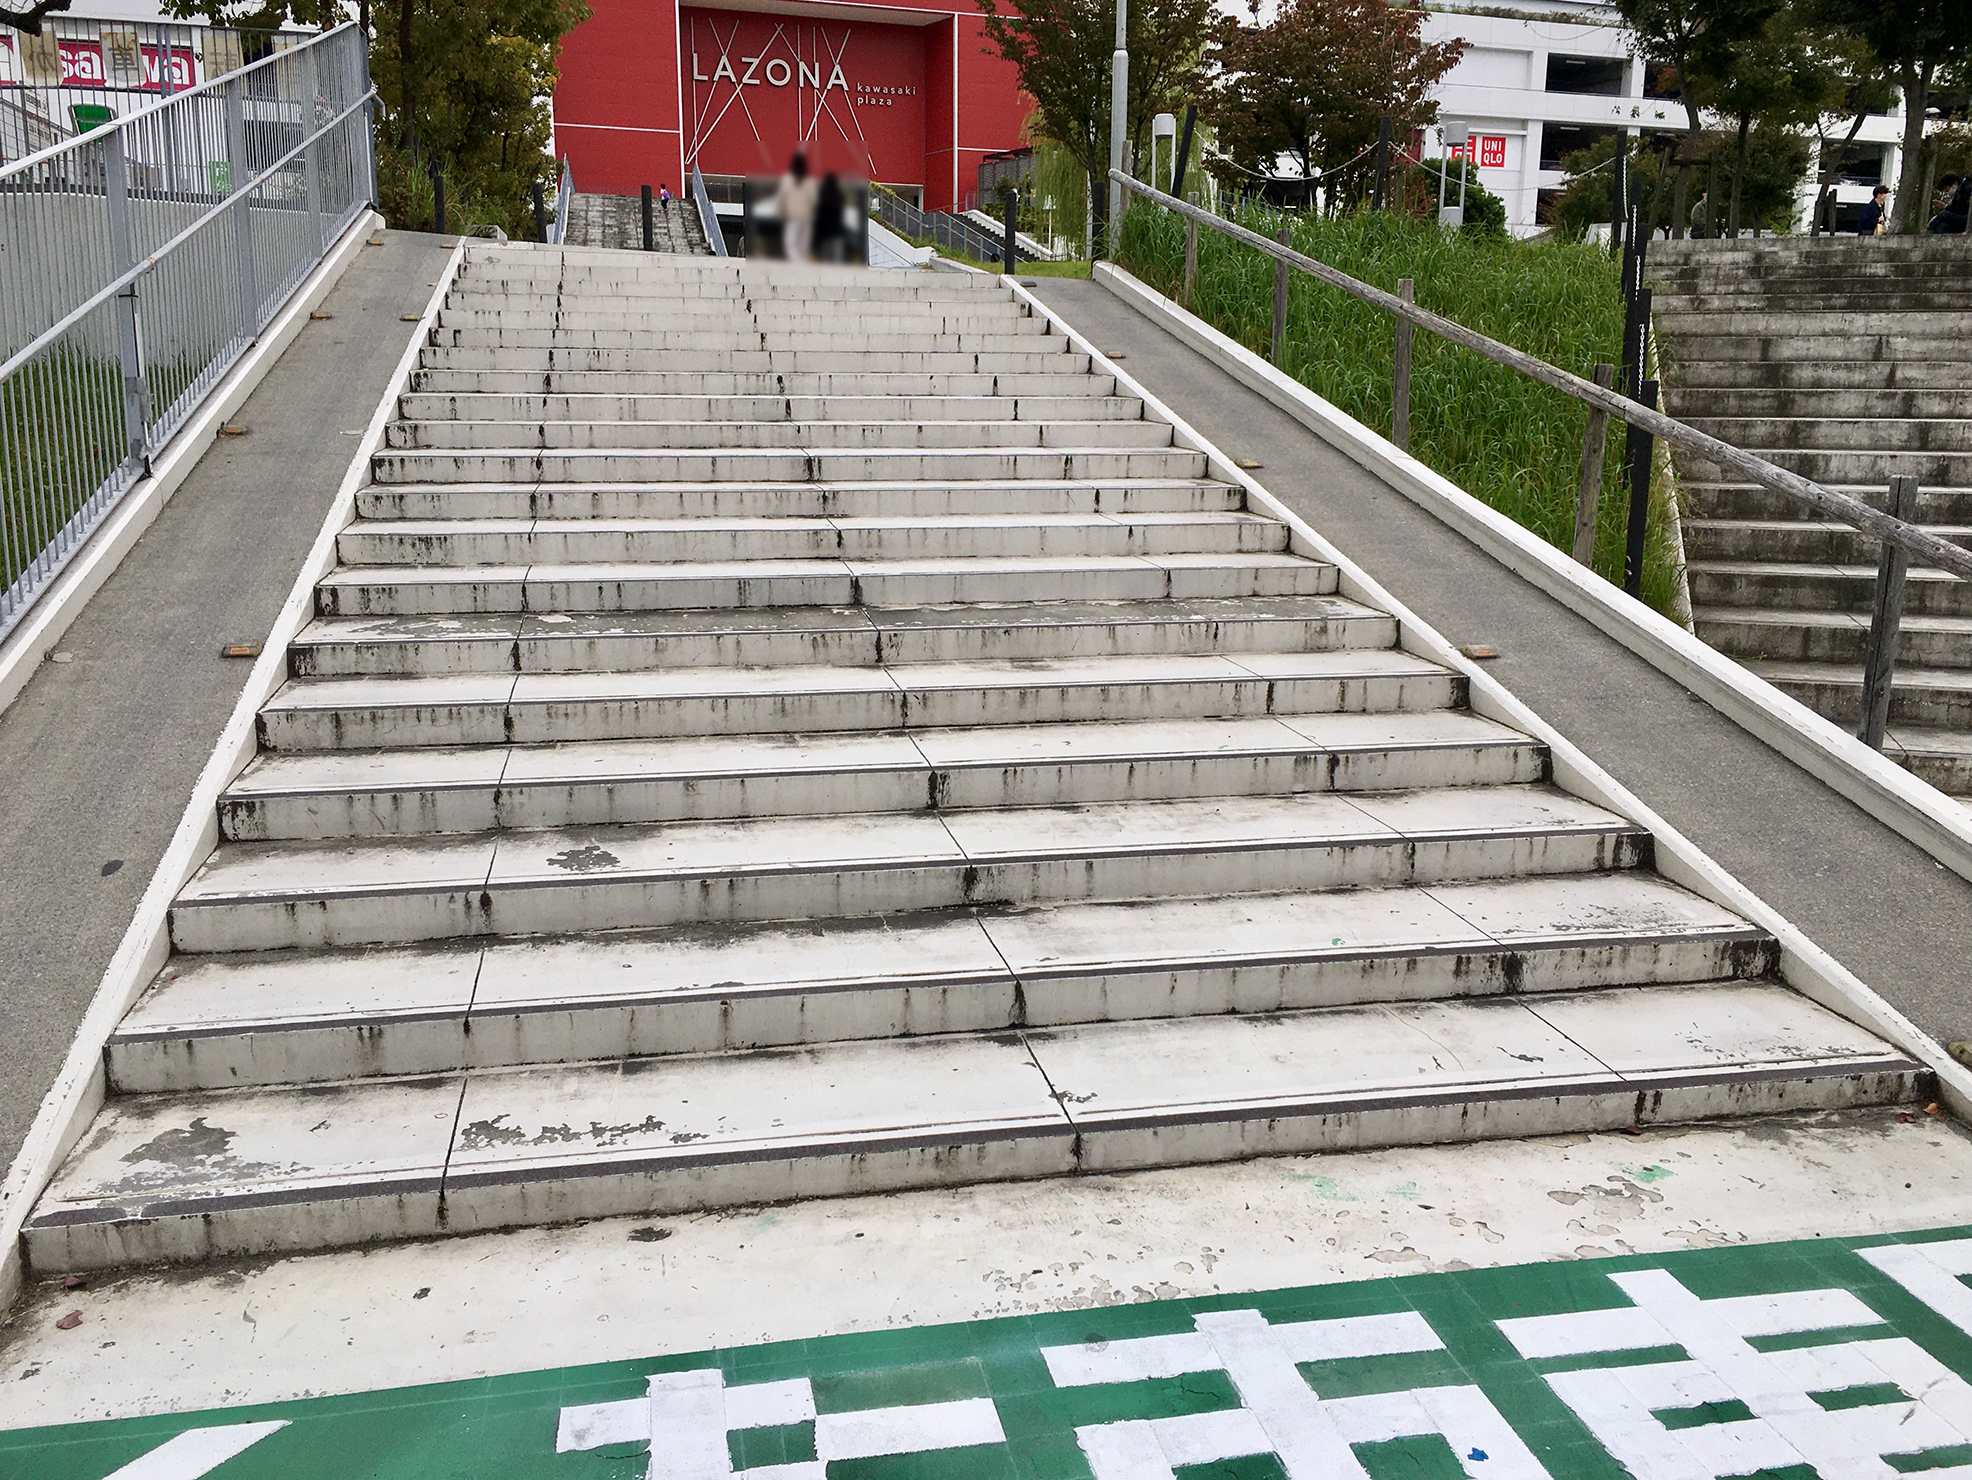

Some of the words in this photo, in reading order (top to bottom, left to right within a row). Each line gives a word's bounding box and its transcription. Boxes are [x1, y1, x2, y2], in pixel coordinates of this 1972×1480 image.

[692, 53, 850, 91] LAZONA
[857, 82, 916, 96] kawasaki
[857, 95, 893, 107] plaza
[1484, 140, 1502, 151] UNI
[1483, 152, 1503, 165] QLO
